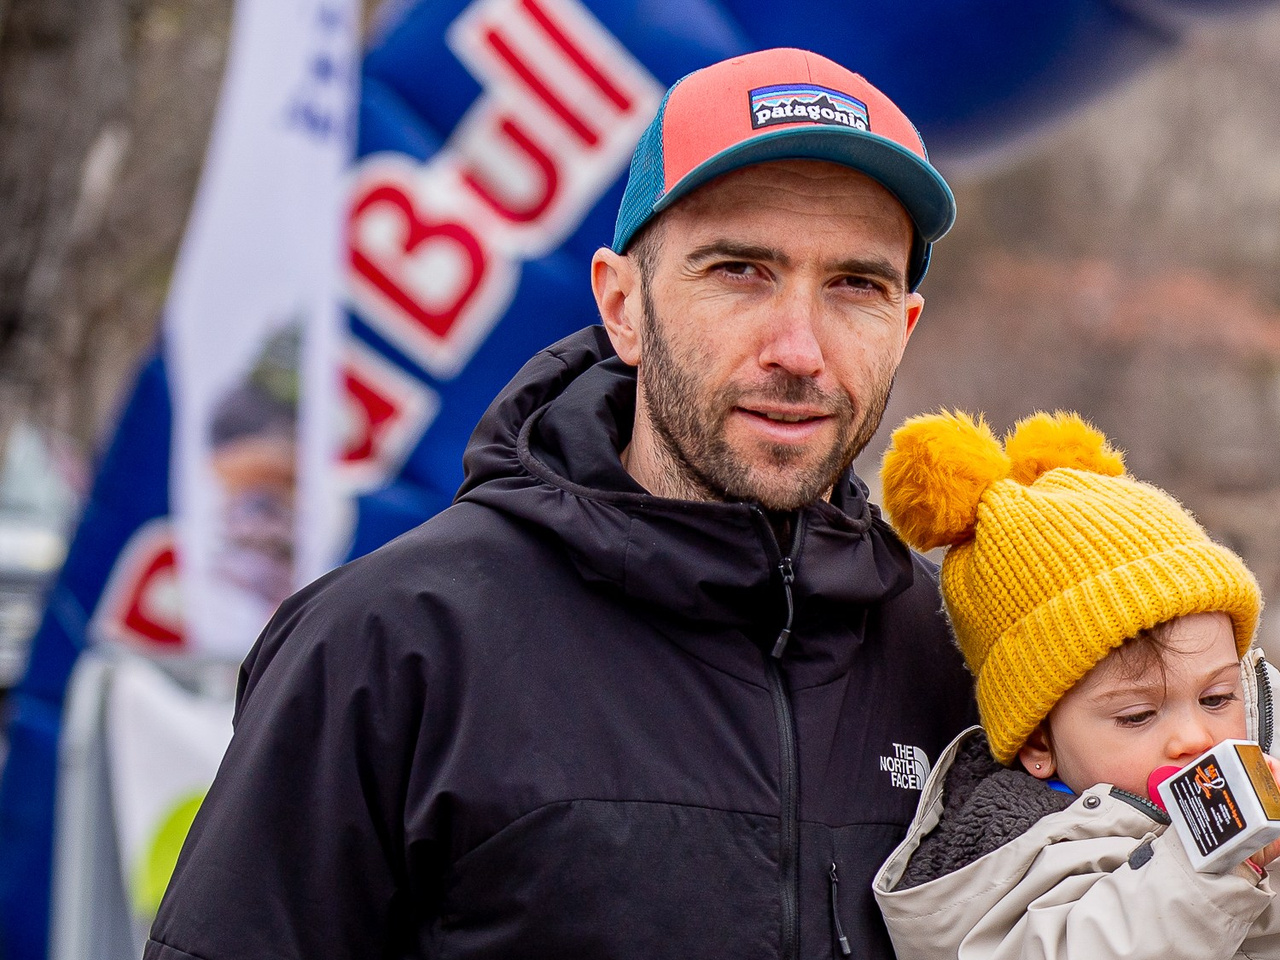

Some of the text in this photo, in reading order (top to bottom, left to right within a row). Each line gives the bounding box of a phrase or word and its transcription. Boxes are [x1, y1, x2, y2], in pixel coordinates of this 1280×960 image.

[756, 103, 866, 132] patagonia
[346, 0, 637, 345] Bull
[892, 742, 914, 760] THE
[880, 755, 915, 775] NORTH
[891, 772, 916, 790] FACE
